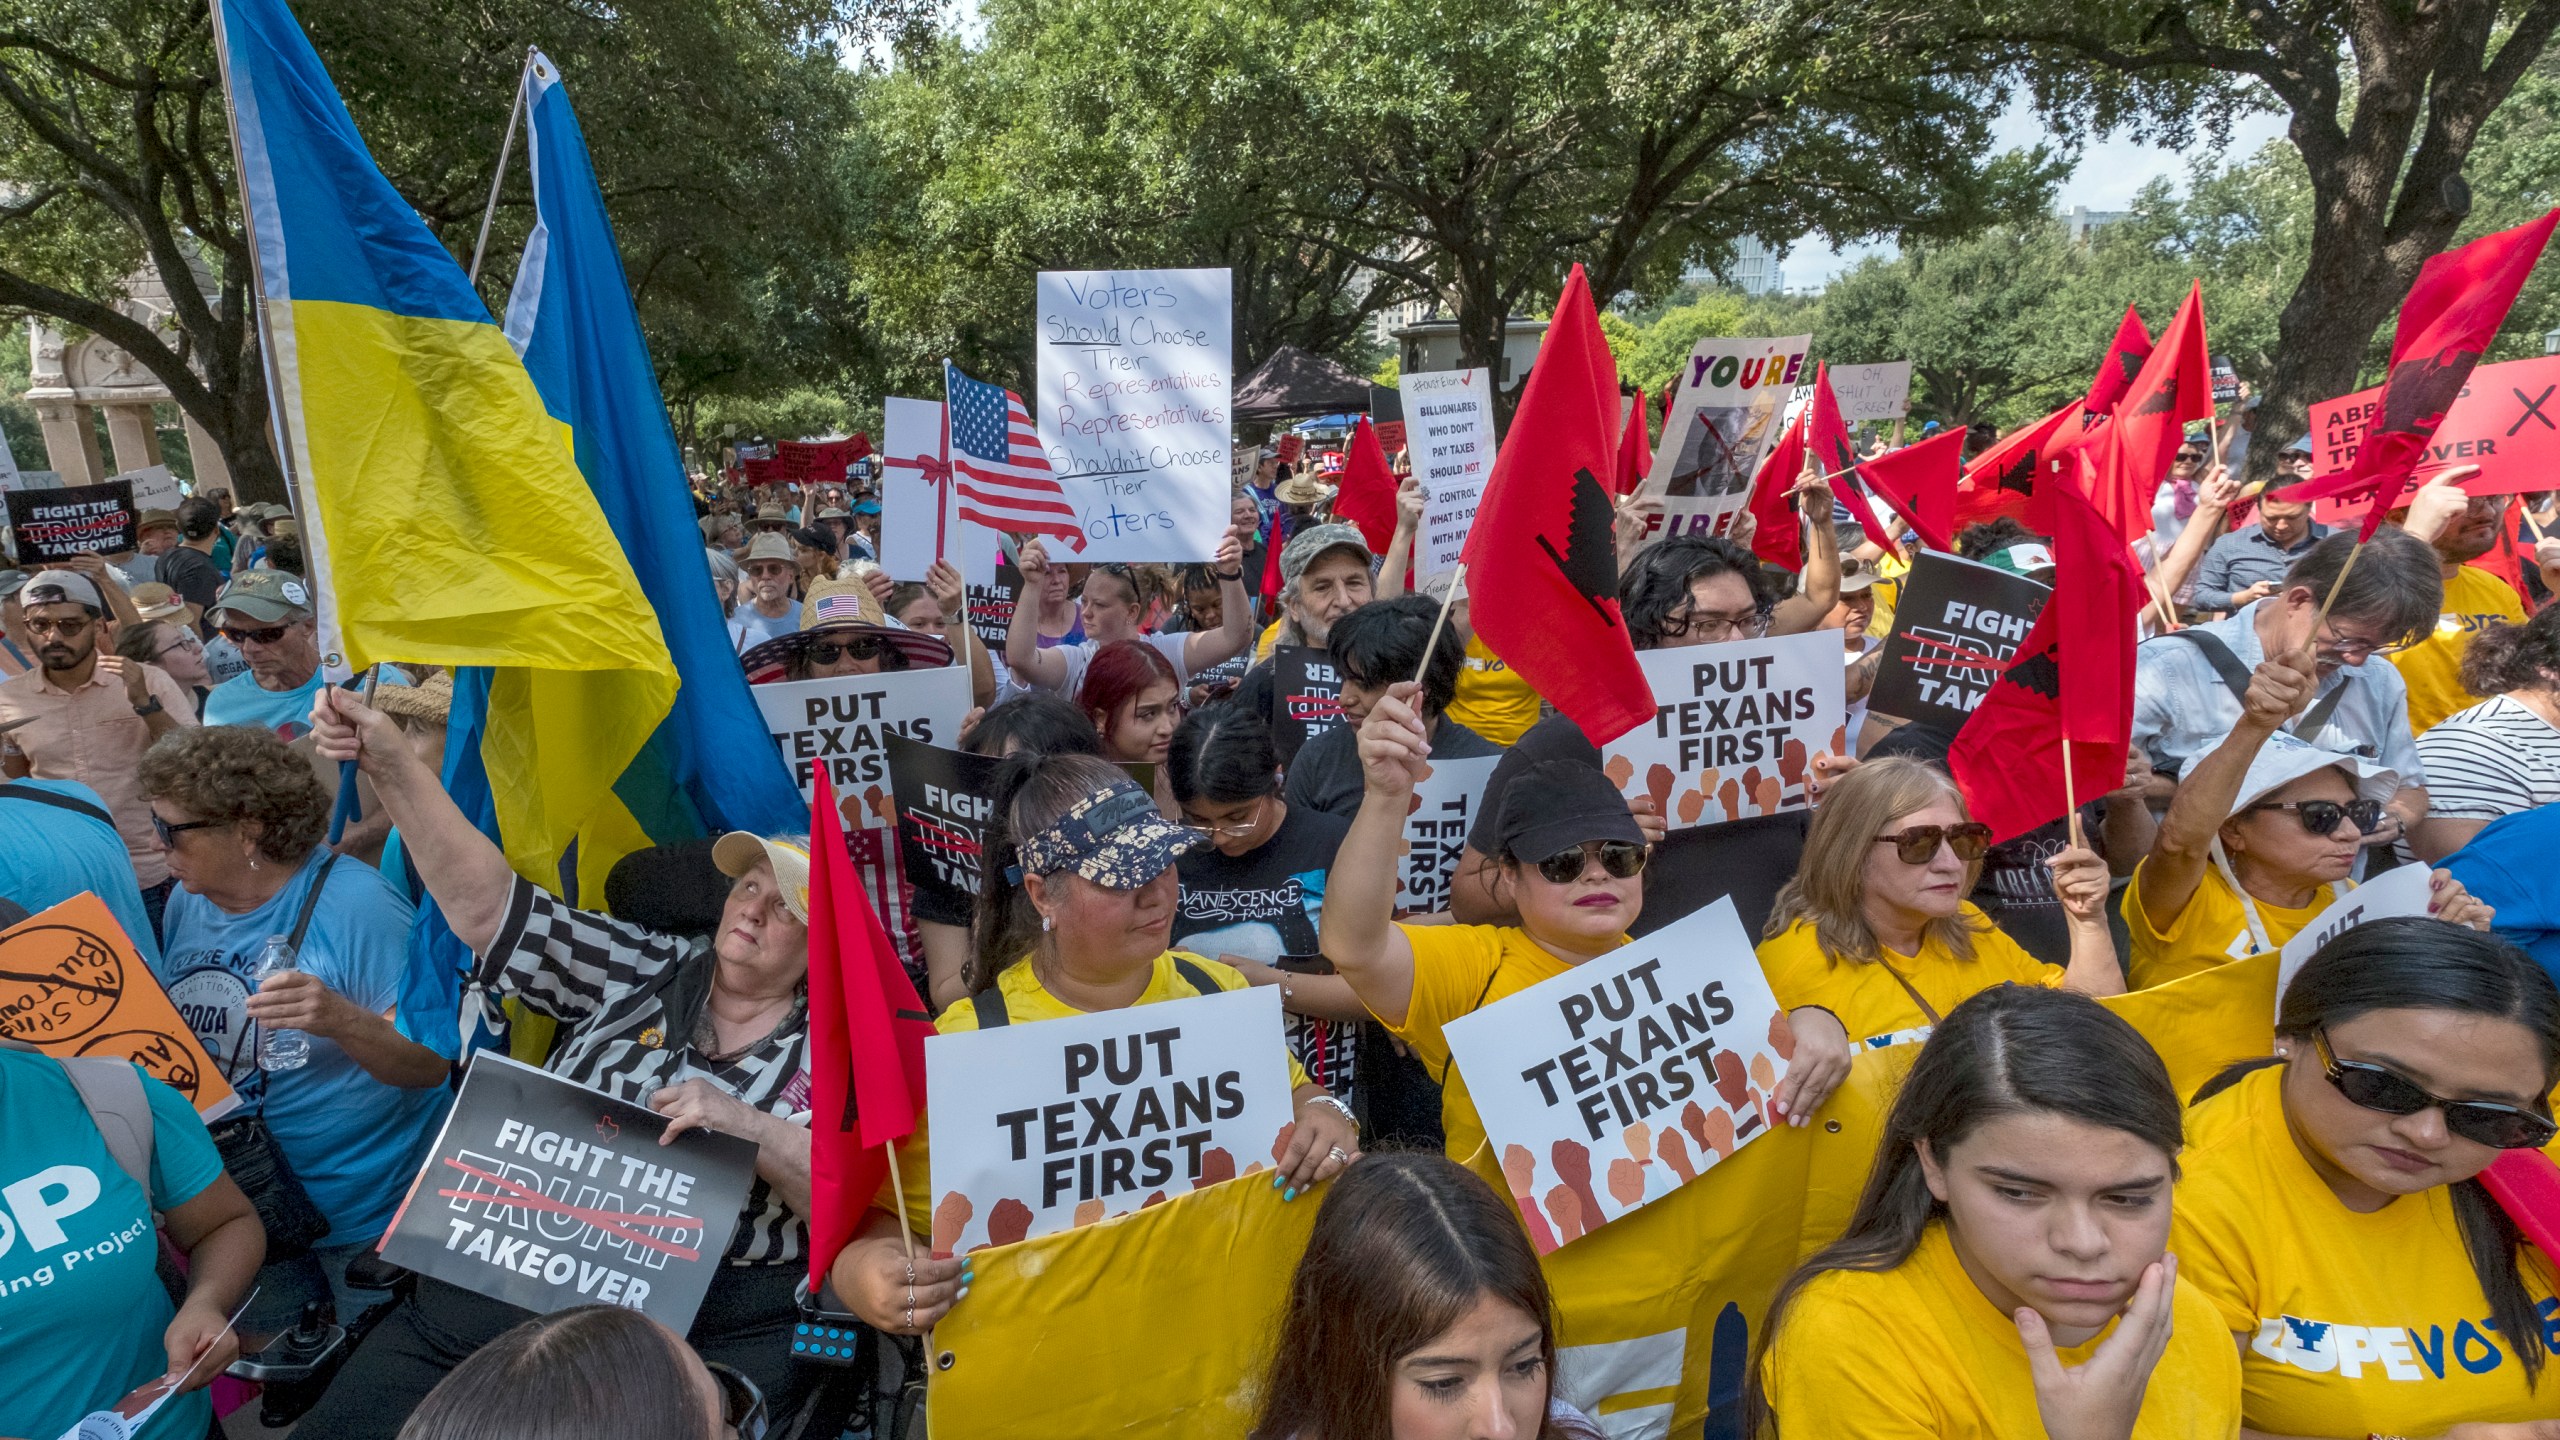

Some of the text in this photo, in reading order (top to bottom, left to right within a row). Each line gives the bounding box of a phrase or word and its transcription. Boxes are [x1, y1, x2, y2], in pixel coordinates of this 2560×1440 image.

[1064, 275, 1178, 309] Voters
[1046, 315, 1210, 346] Should Choose
[1081, 348, 1149, 370] Their
[1691, 346, 1805, 390] YOU'RE
[1862, 367, 1884, 384] OH,
[1063, 370, 1222, 410] Representatives
[1836, 384, 1901, 399] SHUT UP
[1853, 400, 1893, 416] GREG!
[1058, 404, 1225, 446] Representatives
[1420, 402, 1477, 417] BILLIONIARES
[1428, 422, 1474, 437] WHO DON'T
[1049, 445, 1224, 476] Shouldn't Choose
[1432, 442, 1475, 458] PAY TAXES
[1093, 475, 1148, 496] Their
[1430, 461, 1481, 479] SHOULD NOT
[32, 499, 119, 519] FIGHT THE
[1439, 488, 1477, 504] CONTROL
[22, 511, 129, 543] TRUMP
[1429, 507, 1478, 526] WHAT IS DO
[39, 534, 124, 555] TAKEOVER
[1432, 529, 1468, 545] WITH MY
[1942, 600, 2036, 641] FIGH
[1693, 655, 1774, 697] PUT
[805, 690, 887, 726] PUT
[1655, 687, 1815, 739] TEXANS
[1679, 726, 1792, 772] FIRST
[795, 752, 889, 789] FRS
[909, 806, 985, 871] TR
[1408, 820, 1438, 914] FIRST
[1242, 907, 1284, 921] FALLEN
[1558, 957, 1664, 1041] PUT
[1064, 1026, 1181, 1095] PUT
[1520, 979, 1735, 1108] TEXANS
[1576, 1036, 1721, 1142] FIRST
[996, 1070, 1245, 1161] TEXANS
[494, 1118, 696, 1206] FIGHT THE
[1042, 1129, 1212, 1210] FIRST
[0, 1164, 101, 1262] P
[448, 1149, 704, 1271] TRUMP
[61, 1217, 147, 1272] Project
[444, 1218, 651, 1310] TAKEOVER
[2251, 1296, 2560, 1381] LUPEVOE
